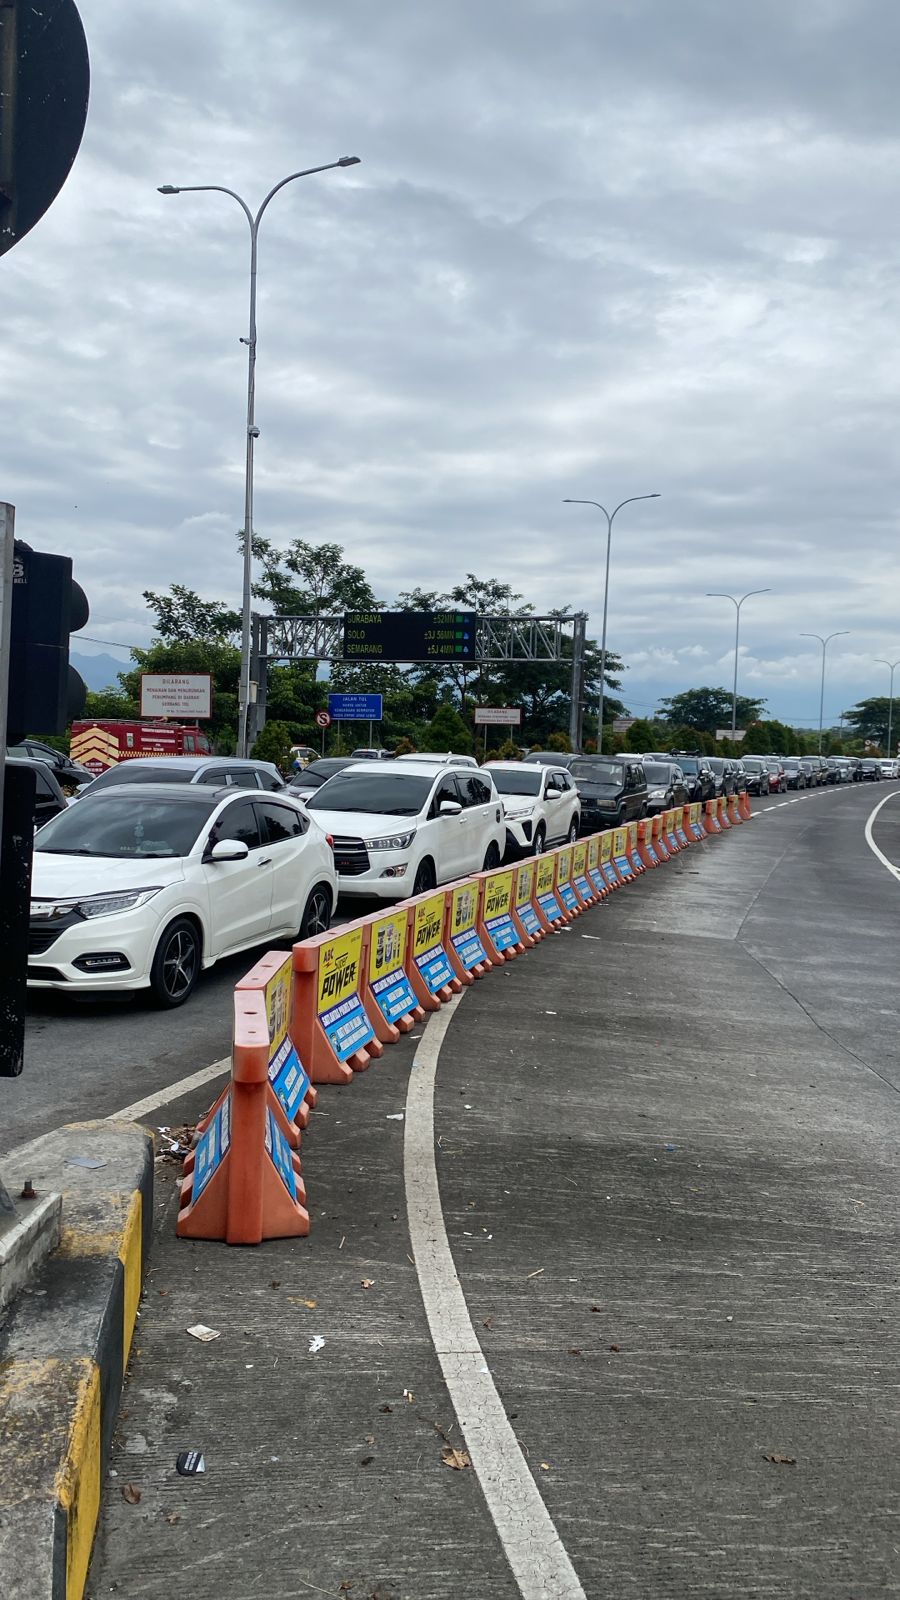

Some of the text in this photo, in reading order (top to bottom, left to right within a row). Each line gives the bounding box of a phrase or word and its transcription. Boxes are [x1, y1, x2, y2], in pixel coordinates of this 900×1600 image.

[346, 614, 382, 624] SURABAYA
[347, 630, 366, 639] SOLO
[346, 644, 383, 654] SEMARANG
[415, 918, 441, 948] POWER
[323, 947, 334, 962] ABC
[320, 960, 357, 1000] POWER
